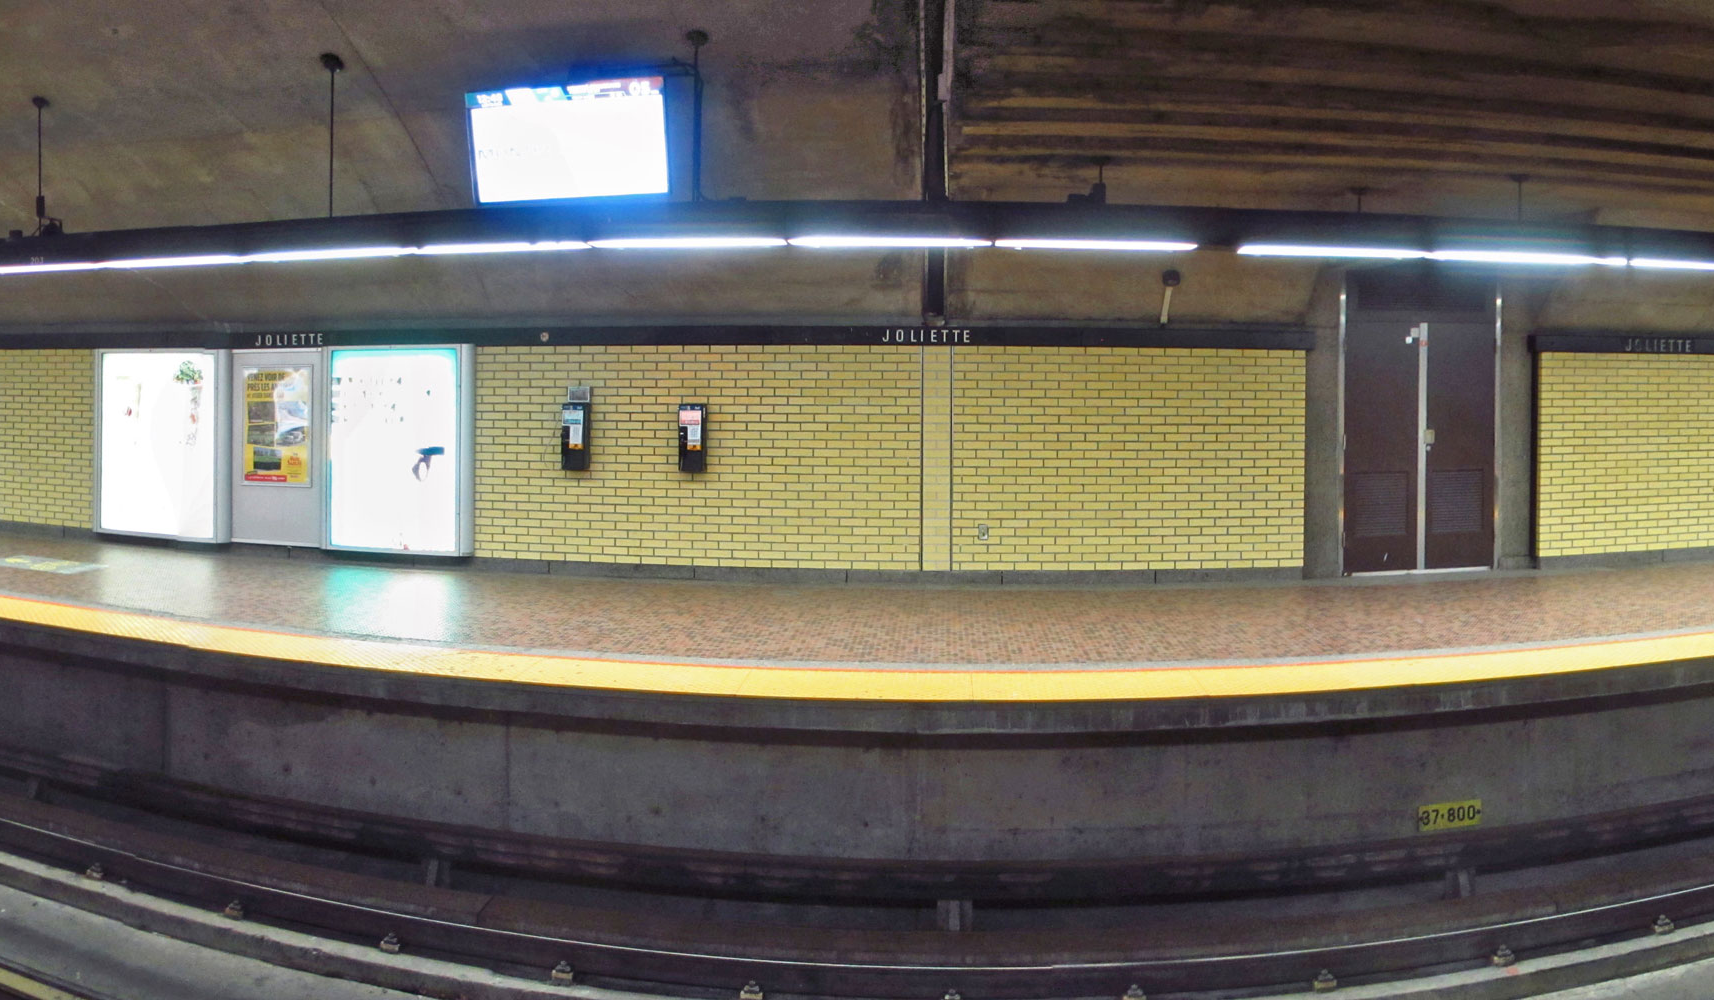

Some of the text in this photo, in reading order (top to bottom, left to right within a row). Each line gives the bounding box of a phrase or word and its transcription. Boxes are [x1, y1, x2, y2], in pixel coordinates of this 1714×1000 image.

[254, 333, 324, 346] JOLIETTE
[882, 329, 970, 342] JOLIETTE
[1625, 338, 1692, 353] JOLIETTE
